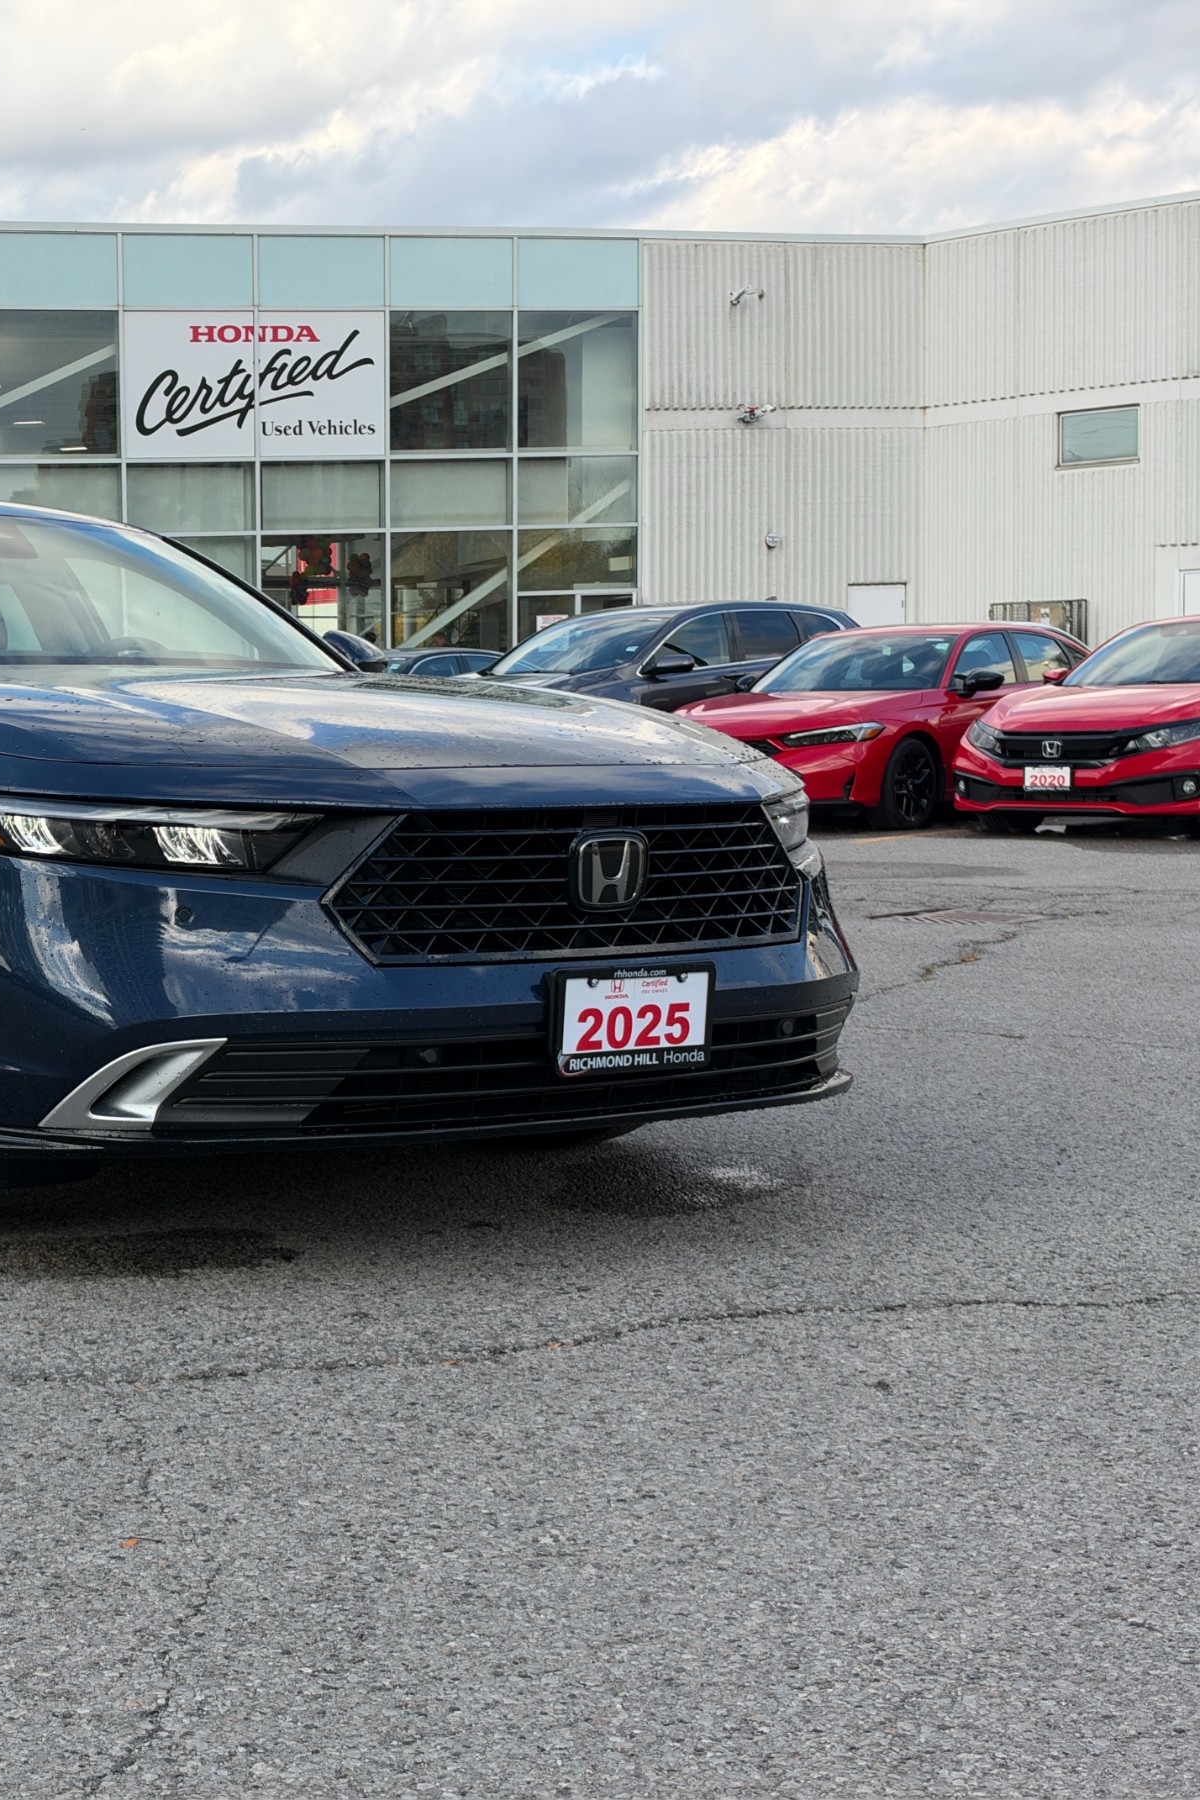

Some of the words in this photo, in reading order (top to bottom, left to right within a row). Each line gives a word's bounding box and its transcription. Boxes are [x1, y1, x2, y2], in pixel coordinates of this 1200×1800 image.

[189, 325, 320, 343] HONDA
[135, 329, 375, 437] Certified
[261, 420, 303, 436] Used
[308, 419, 376, 436] Vehicles
[1030, 775, 1065, 787] 2020
[613, 968, 667, 979] rhhonda.com
[641, 979, 668, 988] Certified
[575, 1002, 690, 1052] 2025
[569, 1054, 633, 1071] RICHMOND
[634, 1053, 659, 1066] HILL
[663, 1049, 705, 1064] Honda
